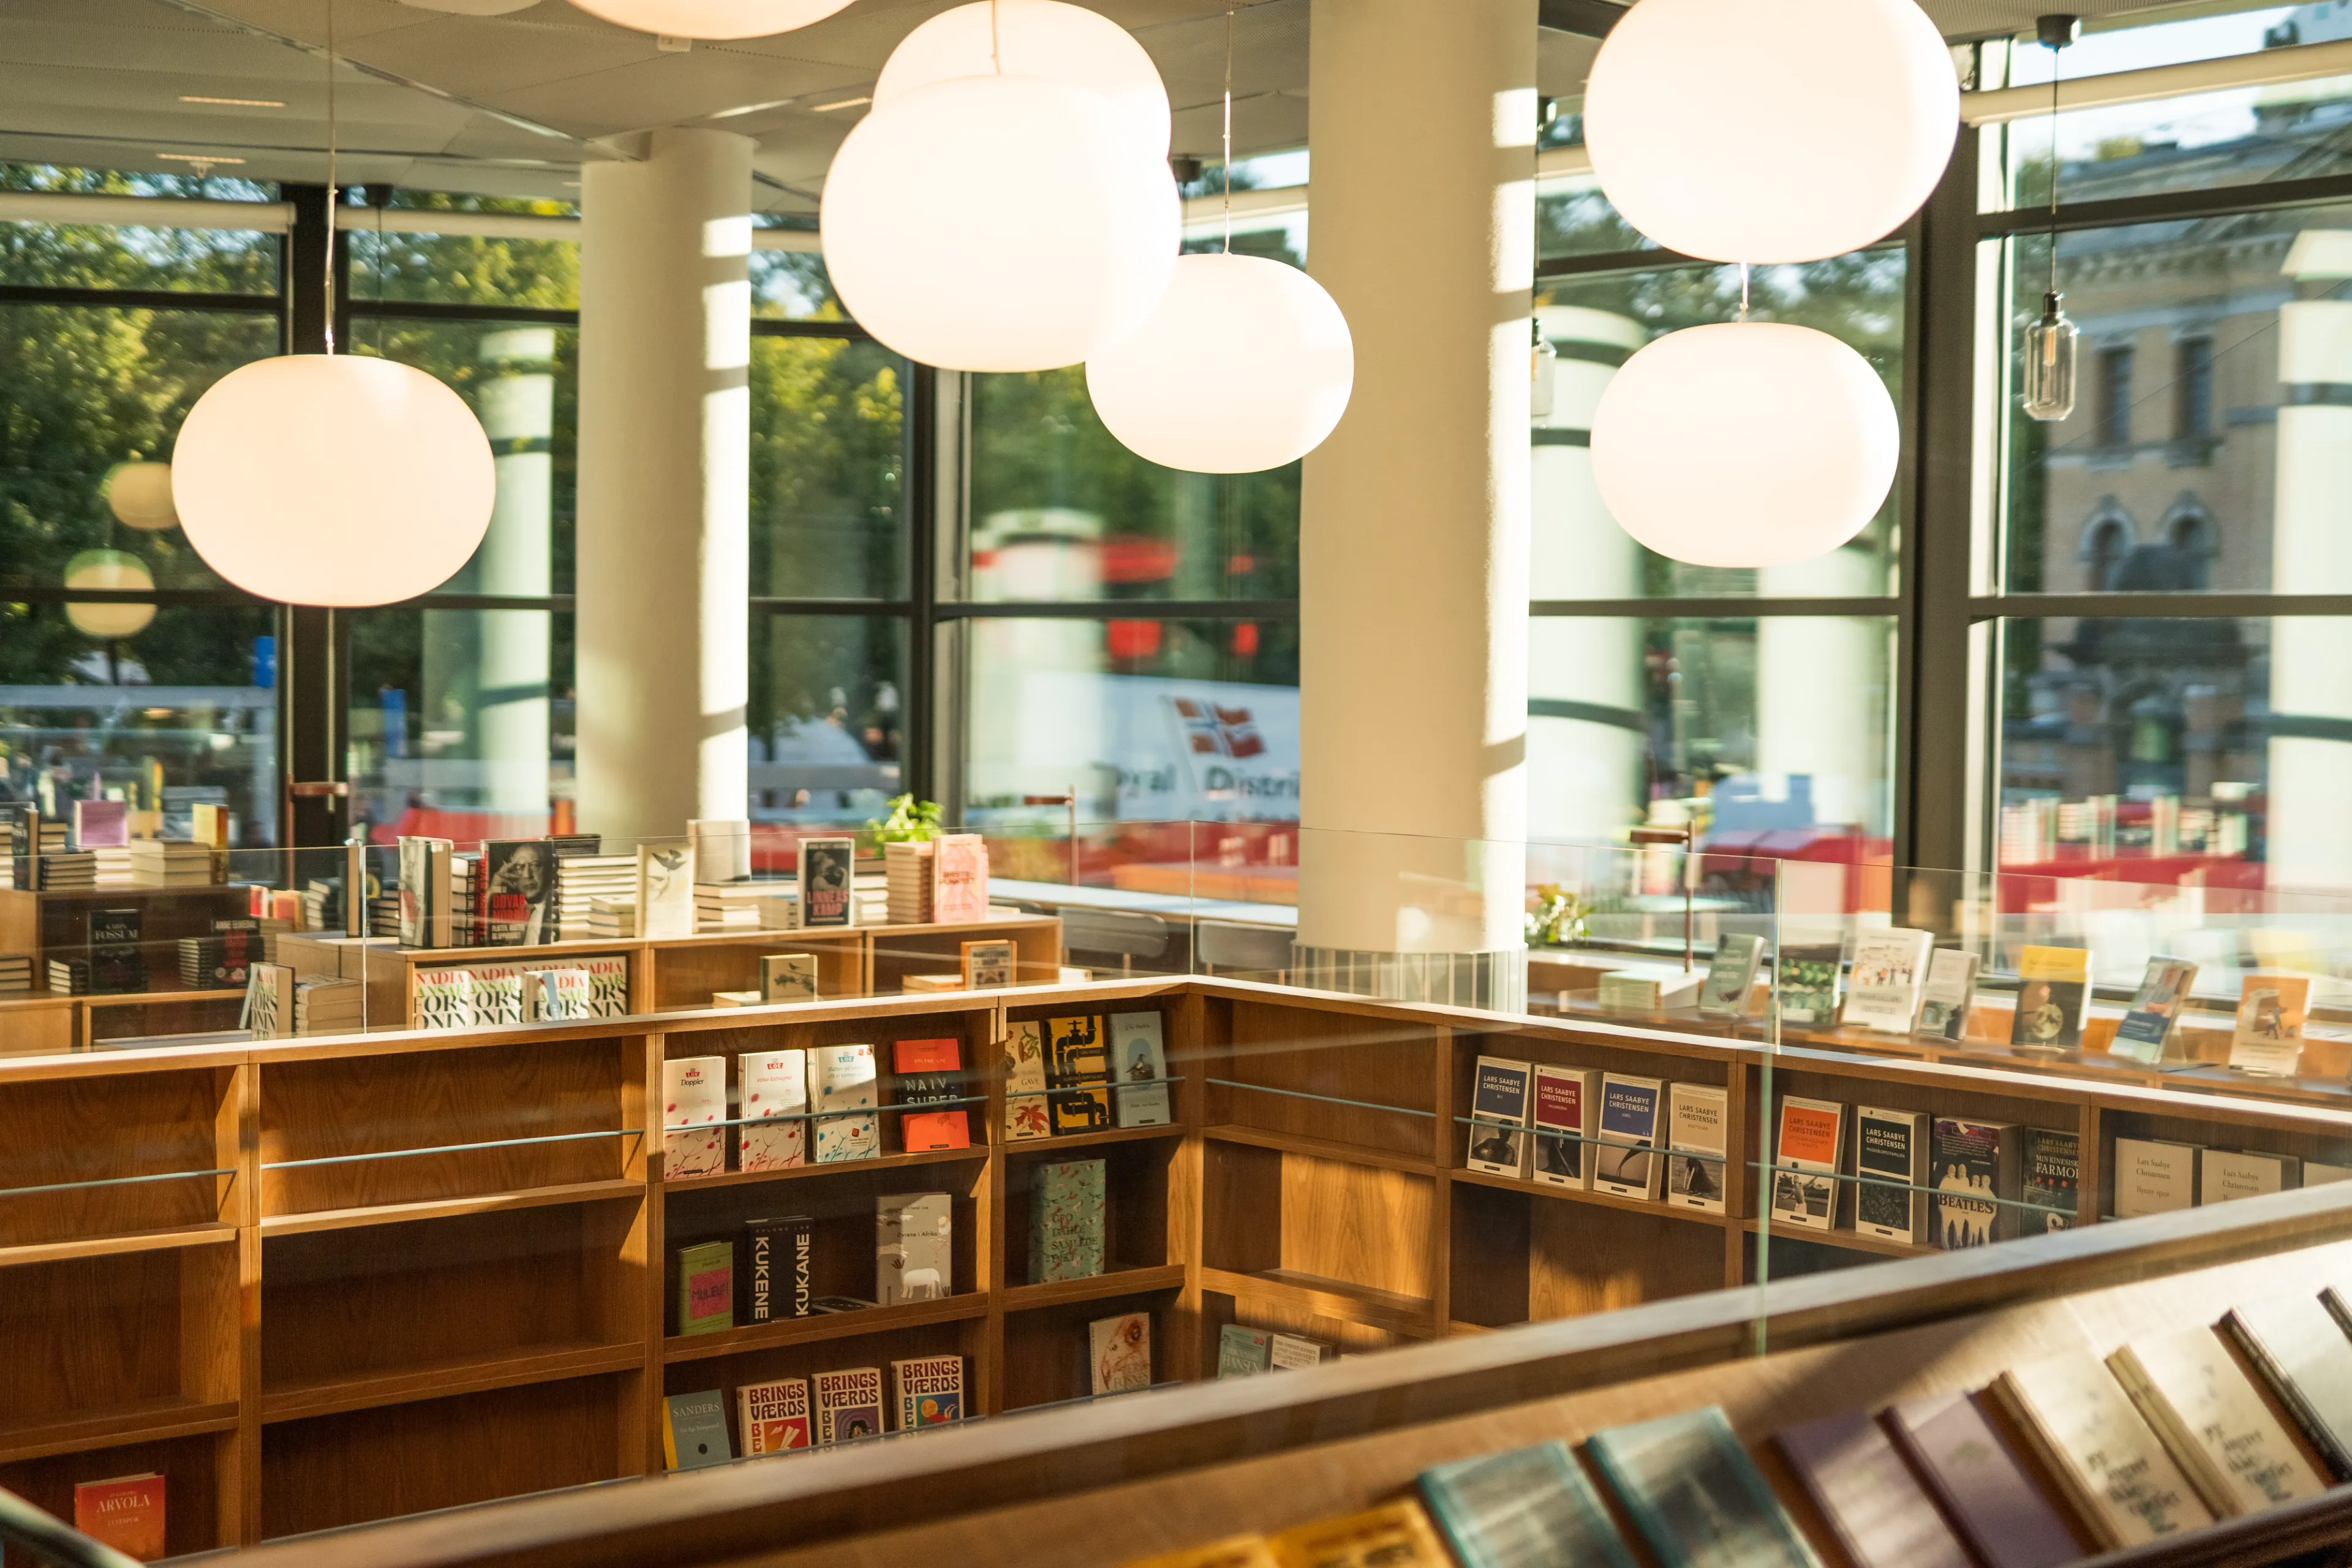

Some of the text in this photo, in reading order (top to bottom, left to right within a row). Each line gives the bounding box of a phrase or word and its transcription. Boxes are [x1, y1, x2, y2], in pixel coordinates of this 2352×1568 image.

[576, 961, 623, 974] NADIA
[416, 971, 464, 985] NADIA
[467, 968, 516, 981] NADIA
[589, 973, 625, 986] NSAR
[469, 980, 517, 995] ANSAR
[538, 976, 585, 989] NDIA
[418, 984, 468, 998] ANSAR
[540, 989, 587, 1002] ASAR
[589, 983, 628, 1001] ORS
[469, 989, 521, 1009] ORS
[589, 1001, 625, 1018] NIN
[680, 1078, 704, 1087] Doppler
[1483, 1082, 1520, 1095] CHRISTENSEN
[1499, 1077, 1521, 1087] SAABYE
[1541, 1092, 1576, 1104] CHRISTENSEN
[1555, 1088, 1576, 1097] SAABYE
[1609, 1100, 1649, 1113] CHRISTENSEN
[1625, 1095, 1649, 1105] SAABYE
[1679, 1104, 1718, 1117] LARS SAABYE
[1679, 1112, 1718, 1125] CHRISTENSEN
[1789, 1117, 1831, 1130] LARS SAABYE
[1789, 1125, 1830, 1137] CHRISTENSEN
[1866, 1128, 1905, 1142] LARS SAABYE
[1866, 1136, 1905, 1150] CHRISTENSEN
[2038, 1137, 2079, 1149] LARS SAABY
[2137, 1156, 2171, 1169] Lars Saabye
[2136, 1168, 2171, 1180] Christensen
[2223, 1168, 2259, 1181] Lars Saabye
[2136, 1185, 2154, 1196] Byens
[2222, 1180, 2260, 1192] Christensen
[1939, 1194, 1994, 1214] BEATLES
[755, 1236, 769, 1319] KUKENE
[795, 1234, 810, 1316] KUKANE
[902, 1360, 960, 1379] BRINGS
[820, 1372, 878, 1392] BRINGS
[903, 1376, 960, 1395] VÆRDS
[749, 1383, 805, 1404] BRINGS
[821, 1389, 878, 1408] VÆRDS
[674, 1401, 720, 1417] SANDERS
[750, 1400, 806, 1420] VÆRDS
[96, 1494, 151, 1513] ARVOLA
